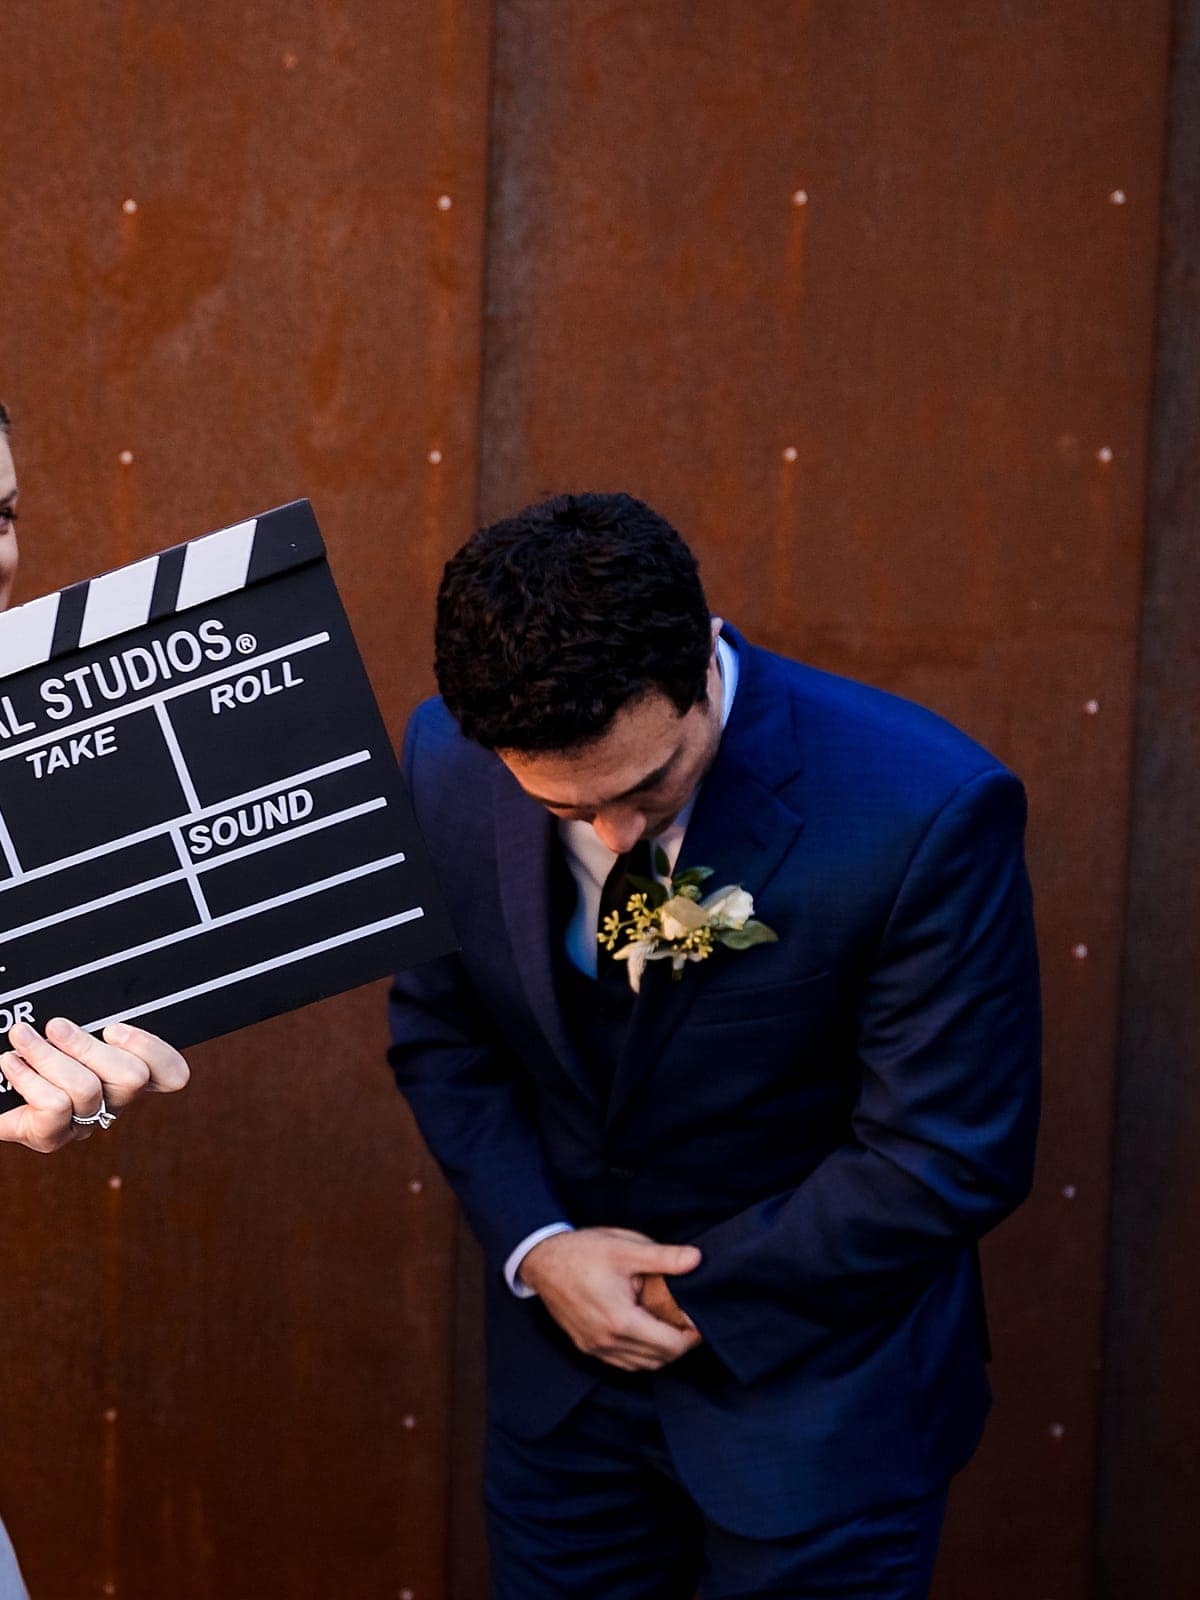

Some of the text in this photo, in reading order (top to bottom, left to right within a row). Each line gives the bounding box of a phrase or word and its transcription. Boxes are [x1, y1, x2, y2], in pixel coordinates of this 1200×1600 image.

[210, 661, 305, 714] ROLL
[25, 725, 118, 779] TAKE
[188, 788, 314, 855] SOUND
